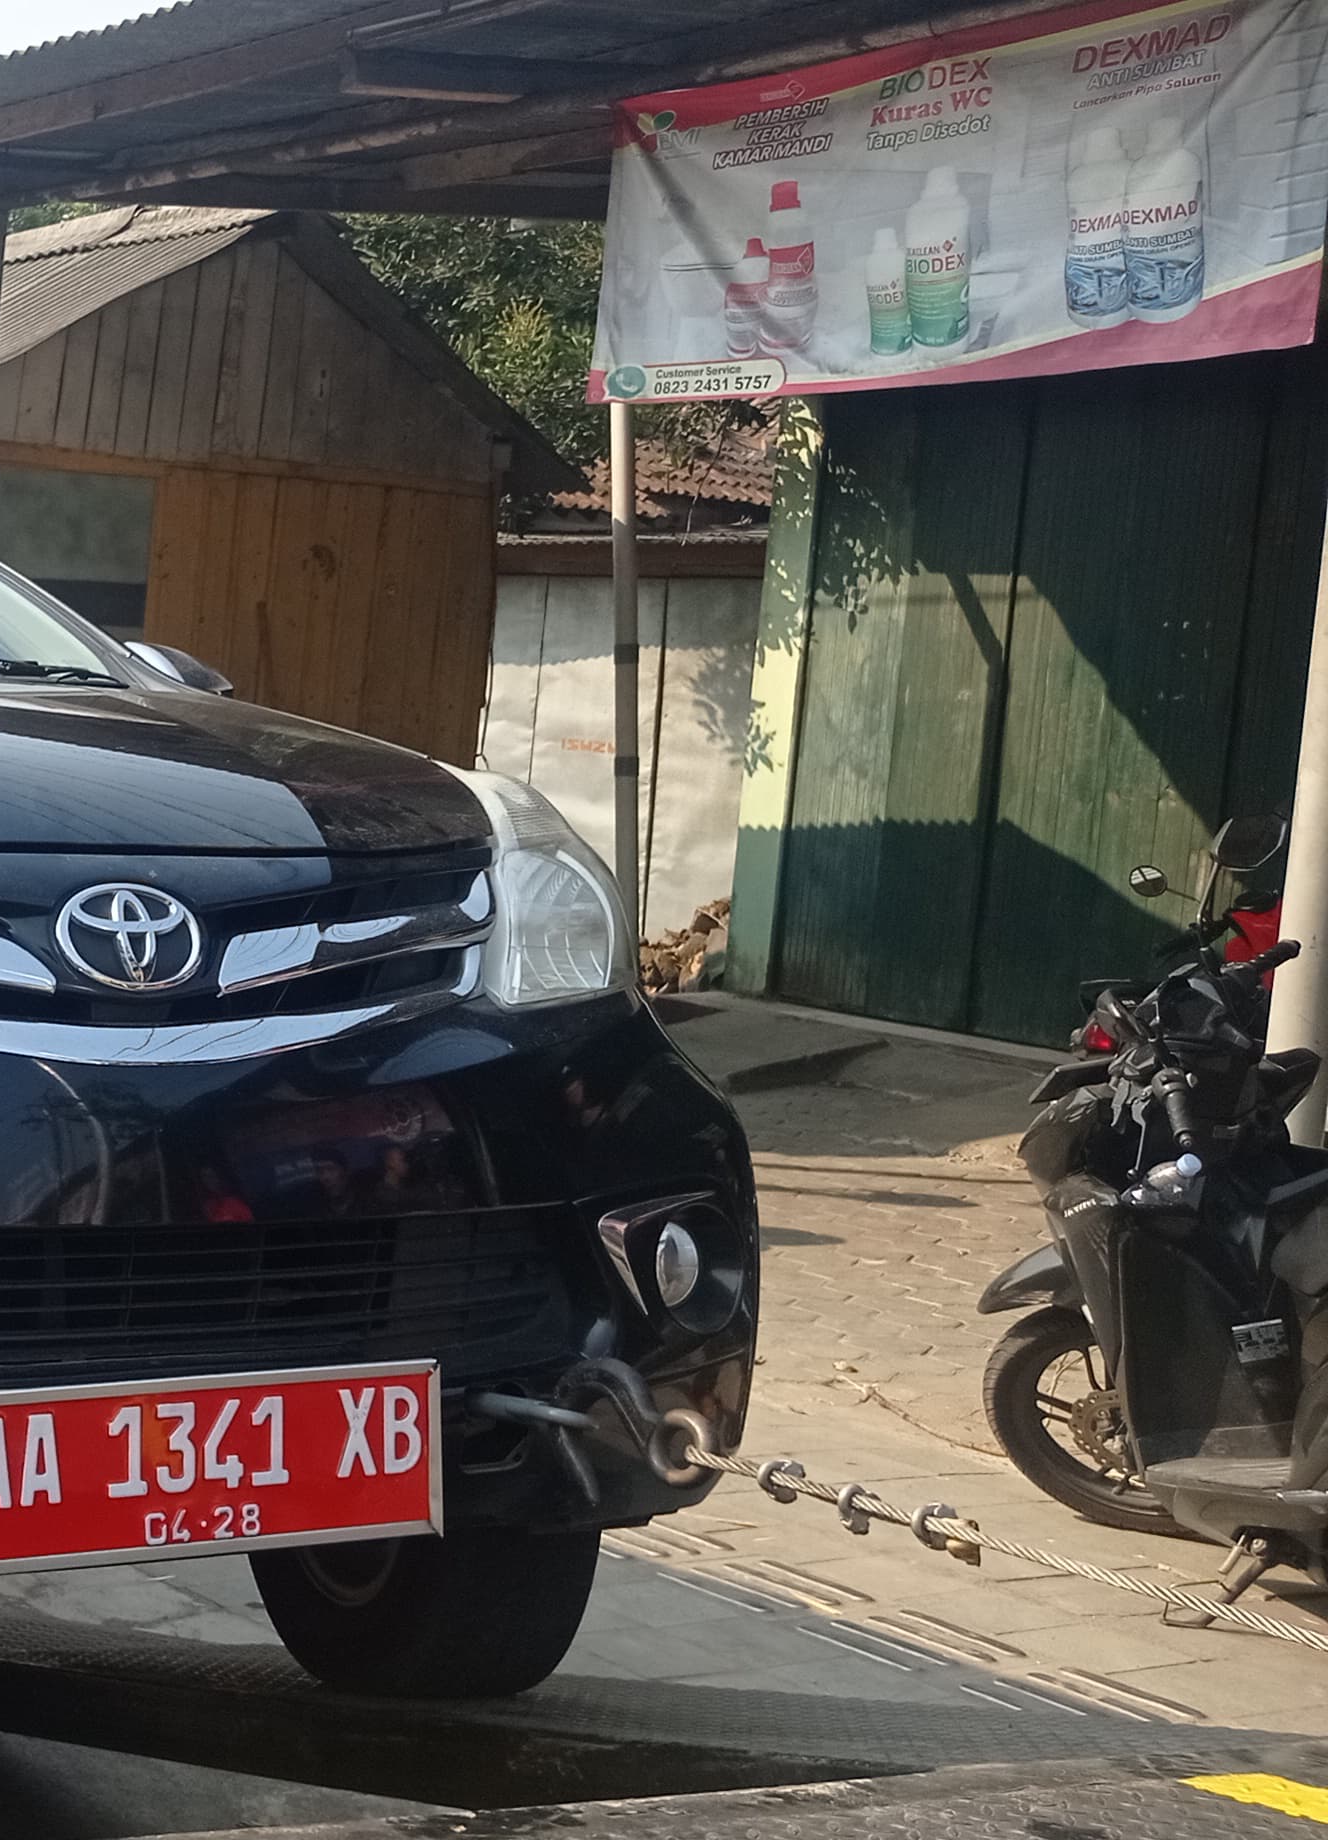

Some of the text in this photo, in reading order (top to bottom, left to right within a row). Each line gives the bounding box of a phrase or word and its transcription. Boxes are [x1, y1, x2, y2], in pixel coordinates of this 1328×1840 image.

[1072, 15, 1232, 73] DEXMAD
[879, 56, 992, 100] BIODEX
[1087, 49, 1206, 91] ANTI SUMBAT
[734, 97, 830, 130] PEMBERSIH
[870, 86, 993, 128] Kuras WC
[746, 121, 806, 146] KERAK
[867, 113, 992, 152] Tanpa Disedot
[711, 134, 833, 170] KAMAR MANDI
[1122, 200, 1199, 225] DEXMAD
[906, 252, 966, 274] BIODEX
[654, 374, 772, 395] 0823 2431 5757
[655, 364, 742, 380] Customer Service
[106, 1395, 290, 1499] 1341
[336, 1385, 423, 1479] XB
